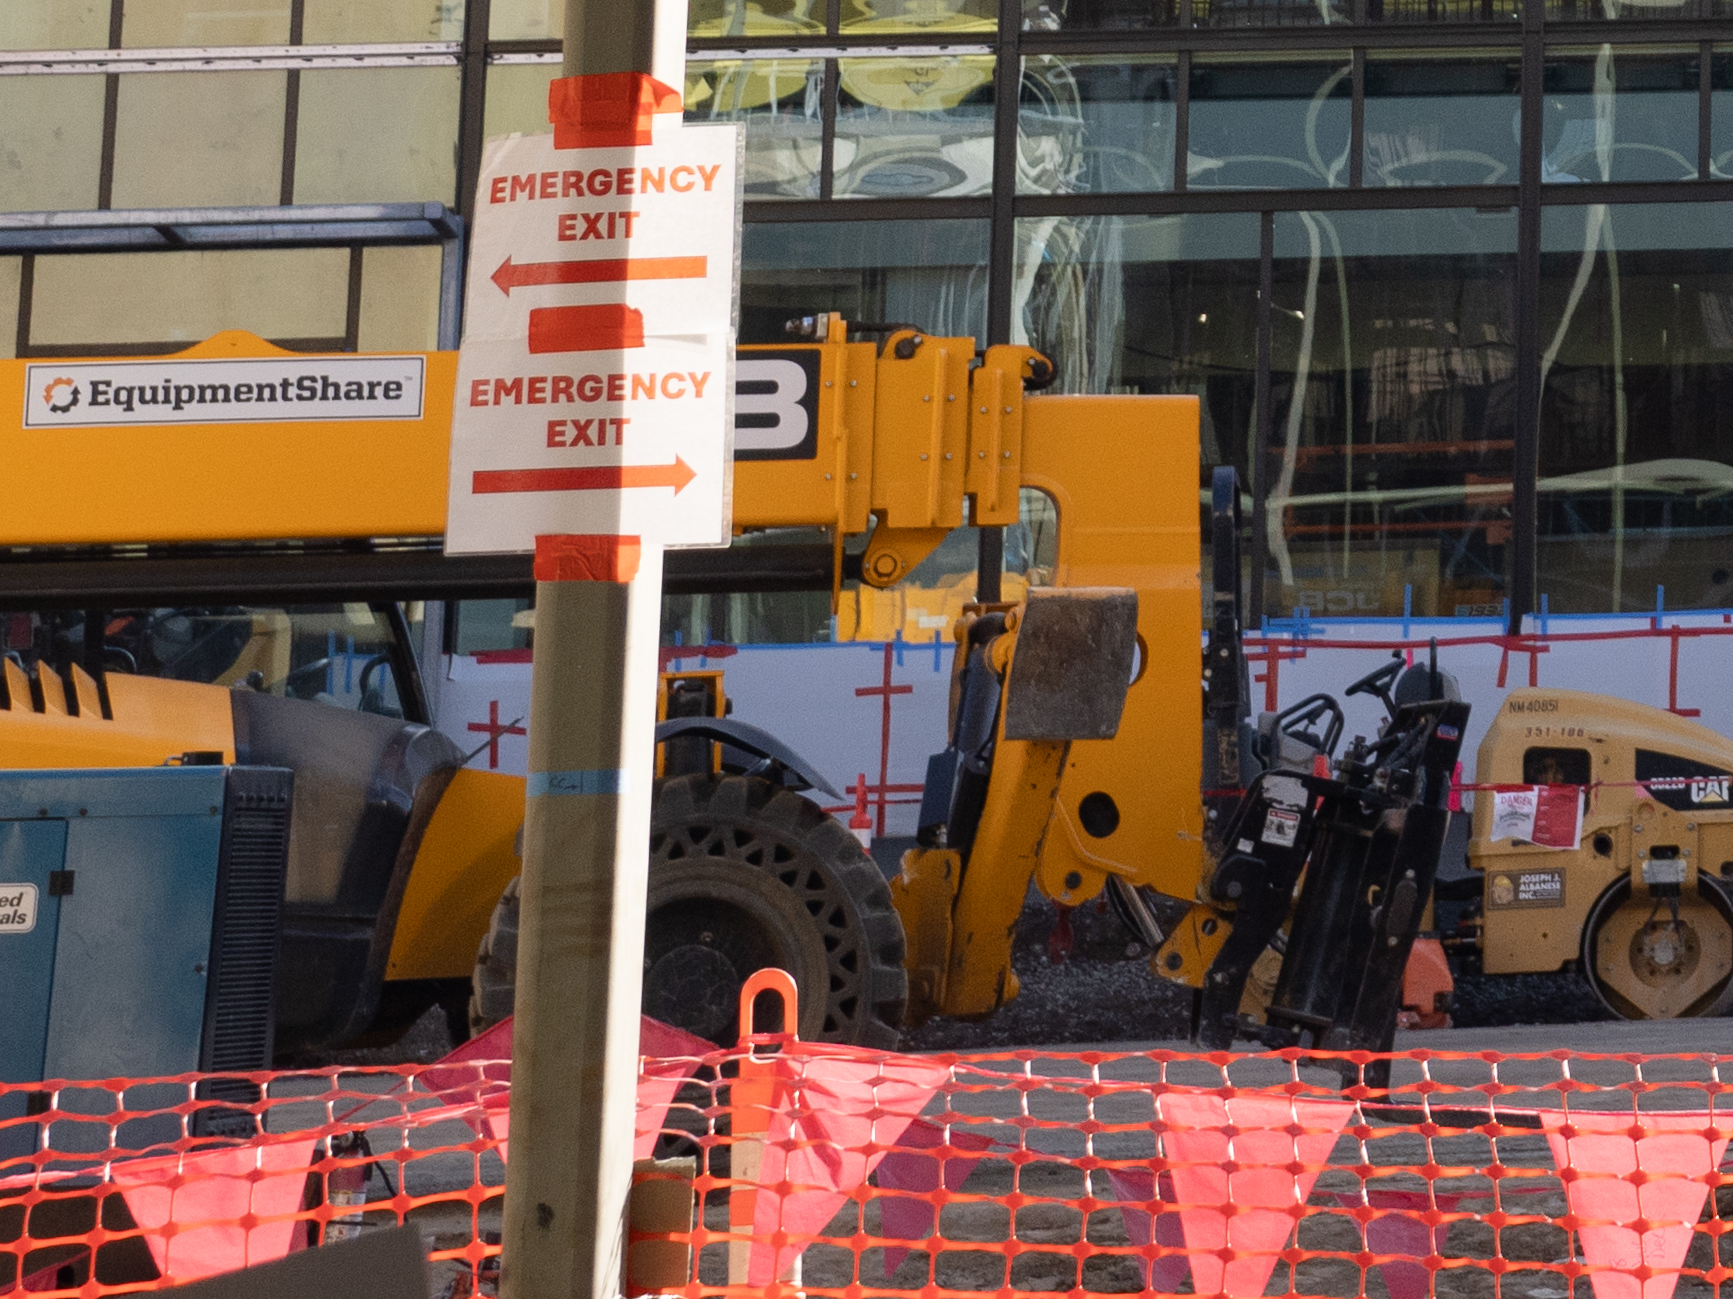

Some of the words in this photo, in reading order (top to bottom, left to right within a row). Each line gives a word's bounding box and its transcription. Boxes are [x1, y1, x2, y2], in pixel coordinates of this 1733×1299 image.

[490, 164, 722, 205] EMERGENCY
[557, 211, 640, 242] EXIT
[89, 374, 403, 413] EquipmentShare
[469, 371, 712, 408] EMERGENCY
[546, 417, 631, 449] EXIT
[1691, 775, 1730, 803] CAT
